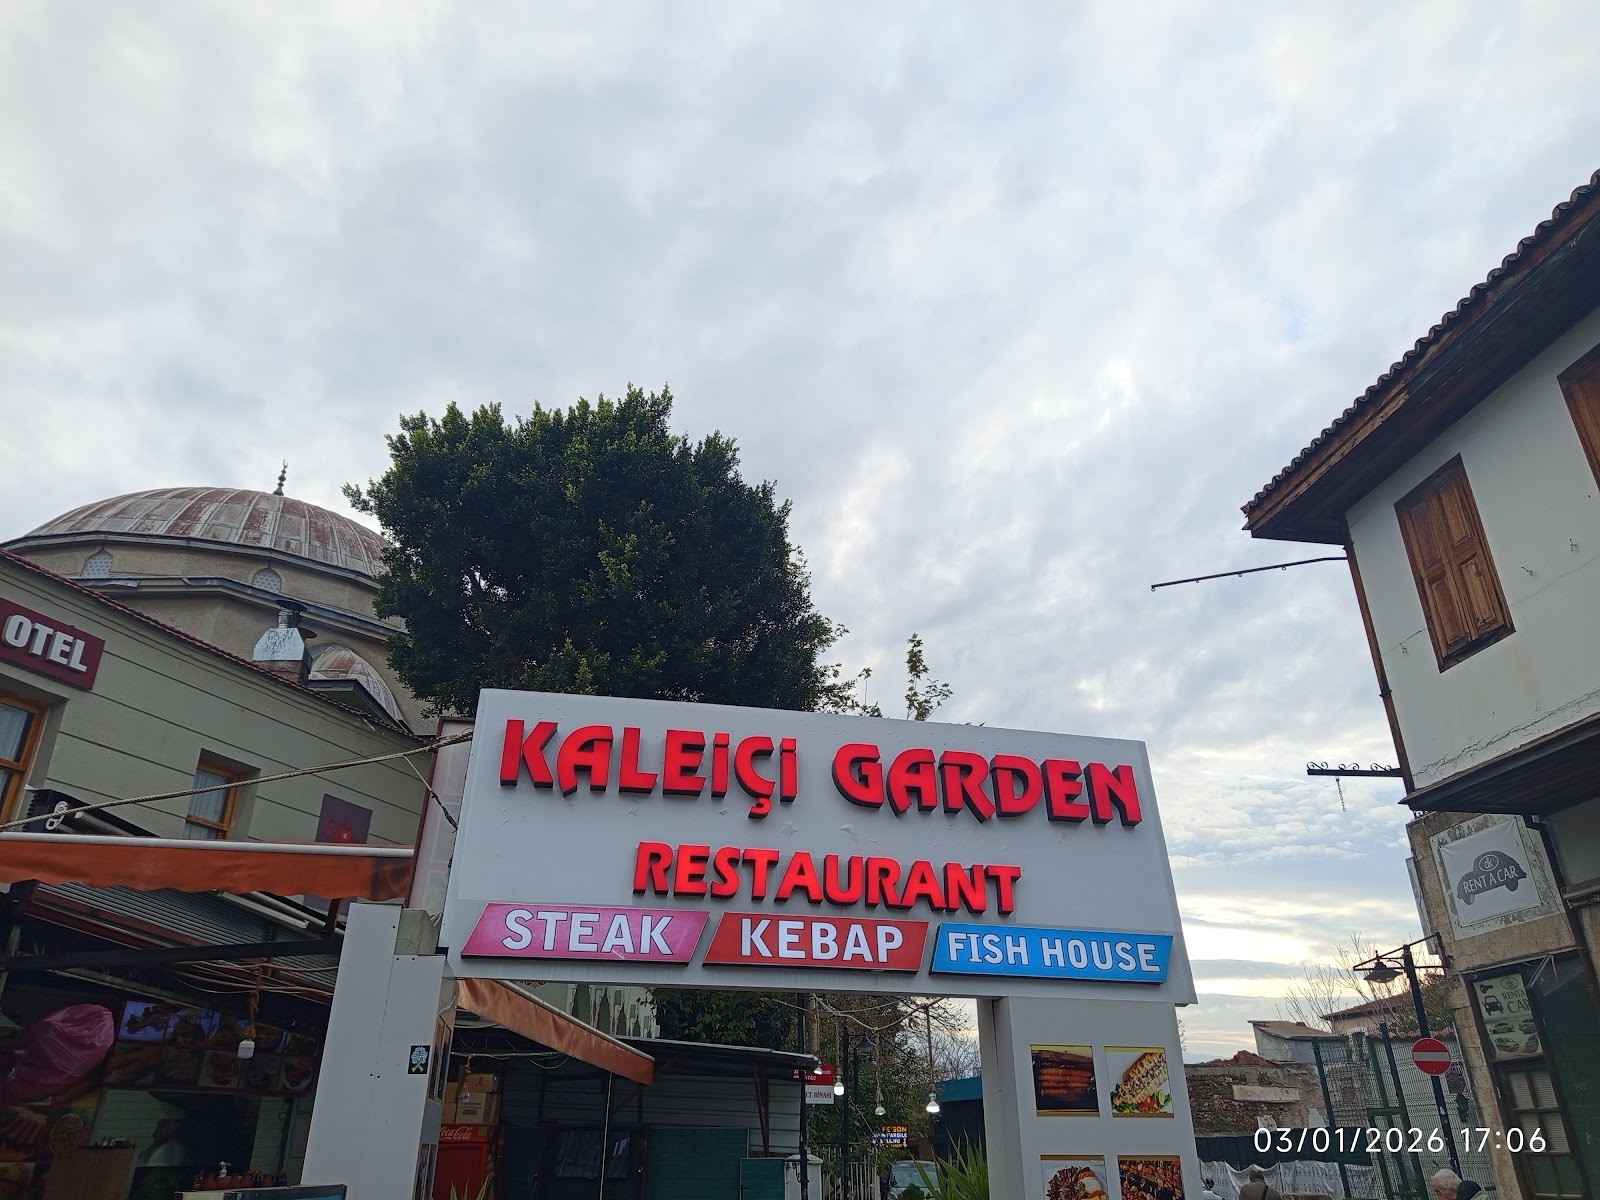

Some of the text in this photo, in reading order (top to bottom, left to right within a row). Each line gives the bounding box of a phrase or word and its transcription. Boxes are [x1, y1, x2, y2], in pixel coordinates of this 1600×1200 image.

[2, 614, 87, 673] OTEL
[833, 741, 1143, 827] GARDEN
[632, 841, 1022, 915] RESTAURANT
[1463, 865, 1519, 894] RENT A CAR
[502, 909, 673, 955] STEAK
[740, 918, 904, 963] KEBAP
[948, 932, 1160, 972] FISH HOUSE
[1501, 989, 1521, 1000] RENT
